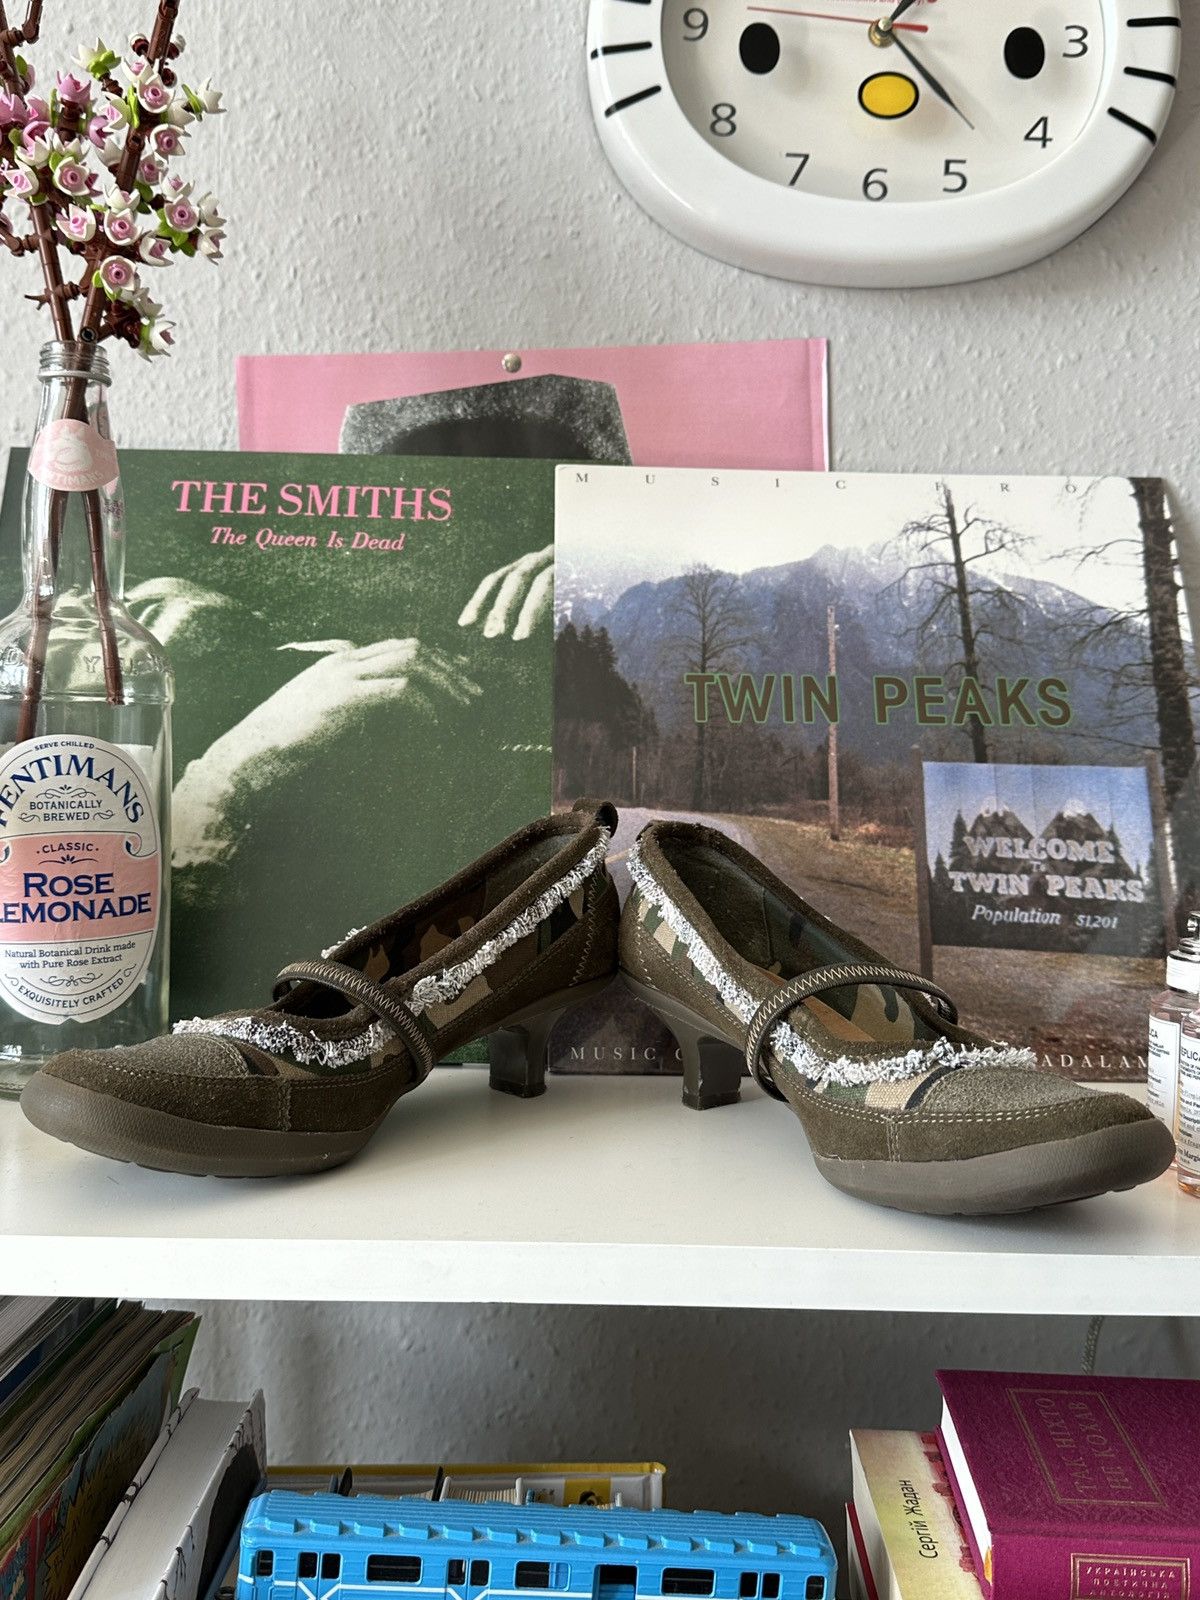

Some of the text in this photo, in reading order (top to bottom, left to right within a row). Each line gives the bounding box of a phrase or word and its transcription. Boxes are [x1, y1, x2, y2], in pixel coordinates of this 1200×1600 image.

[682, 8, 709, 41] 9
[1062, 25, 1089, 58] 3
[709, 103, 738, 137] 8
[1024, 116, 1053, 148] 4
[784, 152, 810, 187] 7
[862, 168, 889, 200] 6
[943, 159, 969, 193] 5
[171, 480, 452, 521] THE SMITHS
[210, 526, 405, 551] The Queen Is Dead
[684, 672, 1074, 728] TWIN PEAKS
[34, 740, 95, 752] SERVE CHILLED
[29, 799, 102, 811] BOTANICALLY
[43, 811, 90, 822] BREWED
[42, 842, 94, 855] CLASSIC
[962, 835, 1115, 864] WELCOME
[23, 872, 115, 898] ROSE
[948, 870, 1146, 903] TWIN PEAKS
[0, 892, 152, 924] EMONADE
[971, 903, 1062, 926] Population
[5, 940, 136, 958] Natural Botanical Drink made
[20, 953, 122, 969] with Pure Rose Extract
[18, 976, 124, 1009] EXQUISITELY CRAFTED
[570, 1046, 657, 1061] MUSIC
[899, 1479, 939, 1559] Сергій Жадан
